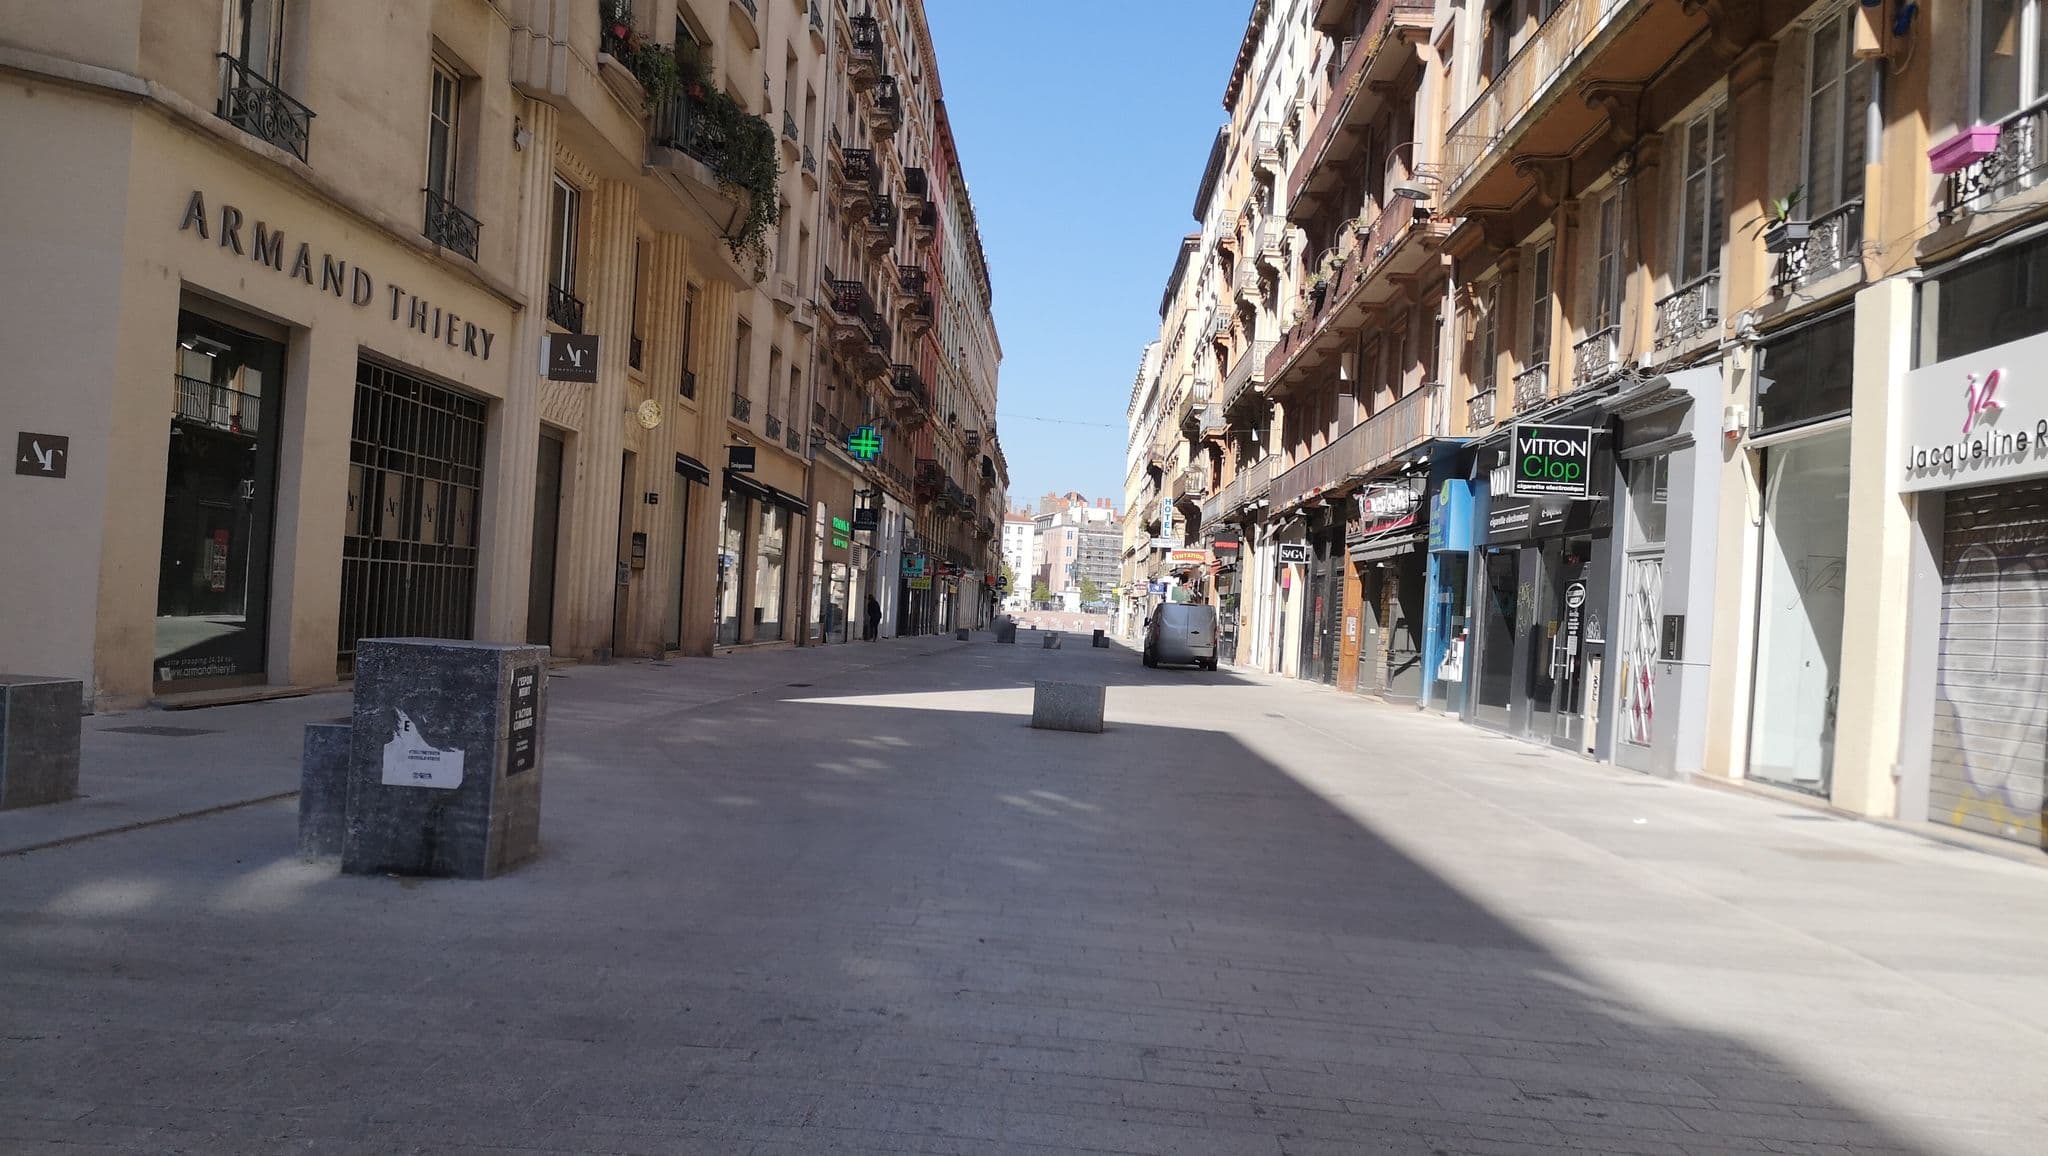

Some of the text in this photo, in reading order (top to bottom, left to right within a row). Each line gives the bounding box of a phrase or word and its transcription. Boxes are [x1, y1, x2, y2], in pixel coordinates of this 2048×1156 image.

[179, 190, 496, 361] ARMAND THIERY
[1519, 428, 1587, 457] VITTON
[1906, 430, 2028, 471] Jacqueline
[1523, 454, 1580, 483] Clop
[643, 492, 659, 505] 16
[1516, 483, 1546, 491] cigarette
[1163, 498, 1172, 537] HOTEL
[1282, 549, 1304, 560] SAGA
